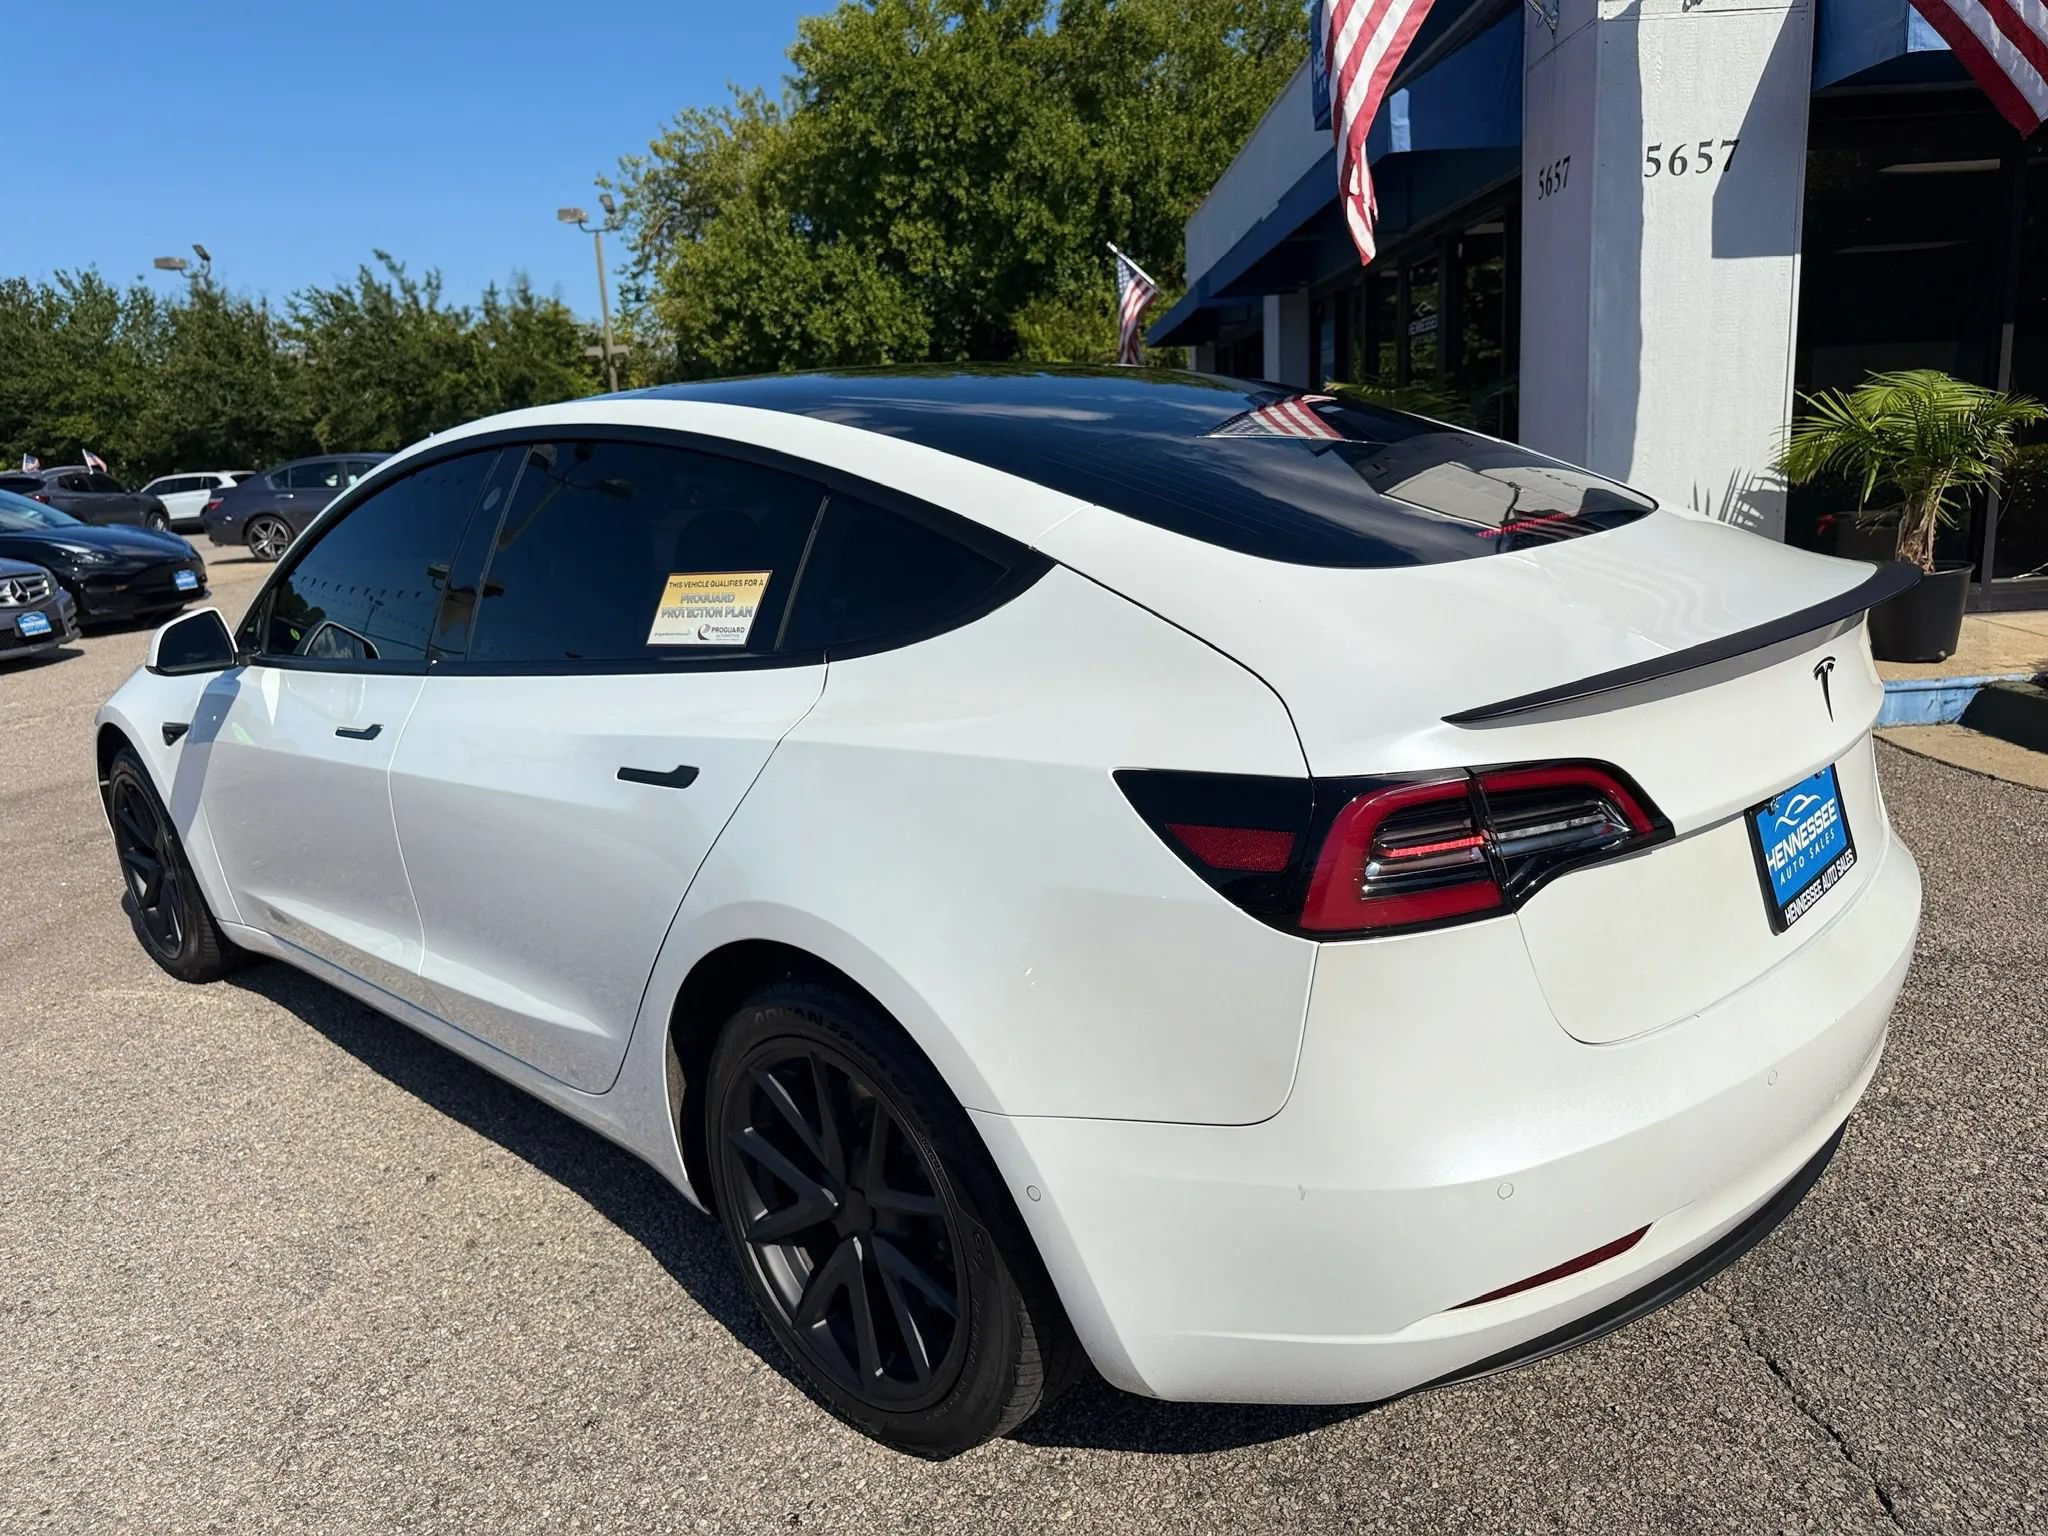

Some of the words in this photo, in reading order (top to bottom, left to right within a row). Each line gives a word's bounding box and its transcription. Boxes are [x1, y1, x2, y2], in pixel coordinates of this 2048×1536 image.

[1537, 154, 1571, 200] 5657
[1643, 137, 1741, 178] 5657
[681, 593, 735, 604] PROGUARD
[684, 580, 710, 588] VEHICLE
[662, 607, 724, 618] PROTECTION
[725, 606, 753, 618] PLAN
[711, 626, 746, 634] PROGUARD
[1765, 797, 1838, 875] HENNESSEE
[1779, 858, 1805, 886] AUTO
[1809, 828, 1835, 860] SALES
[1784, 879, 1824, 926] HENNESSEE
[1821, 867, 1837, 892] AUTO
[1835, 848, 1855, 879] SALES
